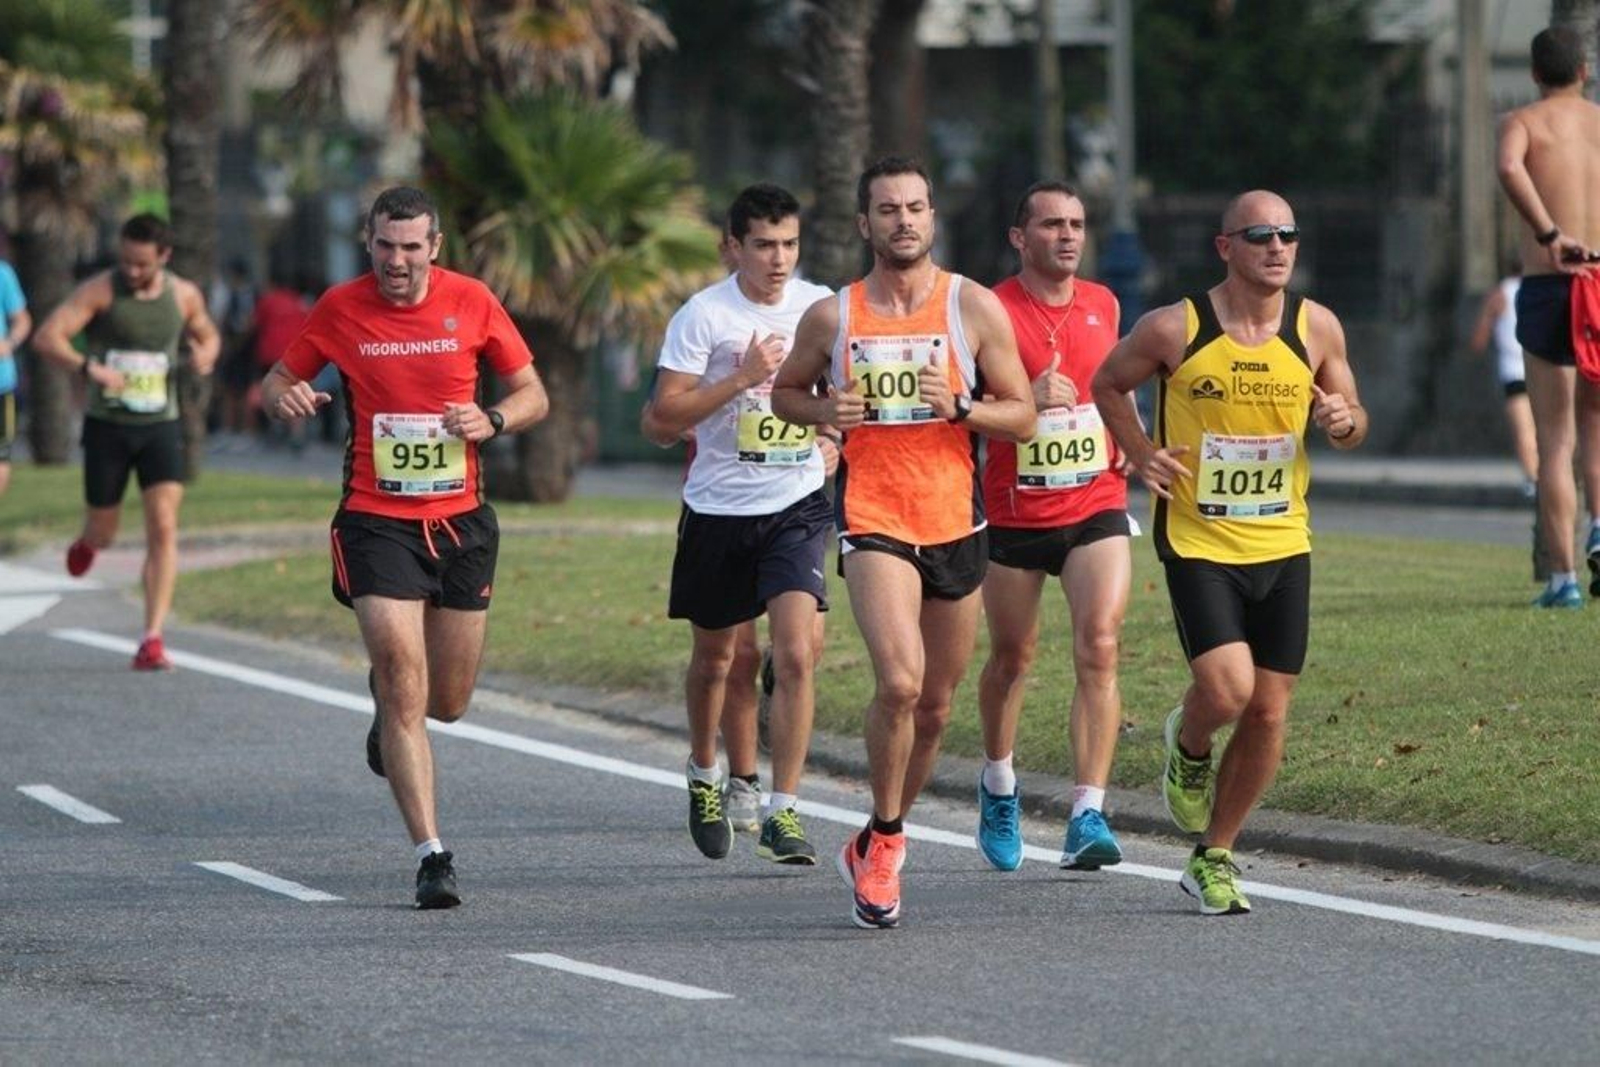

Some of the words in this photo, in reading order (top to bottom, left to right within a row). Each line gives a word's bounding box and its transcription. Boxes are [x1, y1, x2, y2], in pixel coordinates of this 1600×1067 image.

[359, 338, 458, 356] VIGORUNNERS
[861, 371, 916, 398] 100
[1232, 376, 1300, 397] Iberisac
[392, 442, 448, 470] 951
[1028, 437, 1095, 466] 1049
[1211, 468, 1283, 496] 1014
